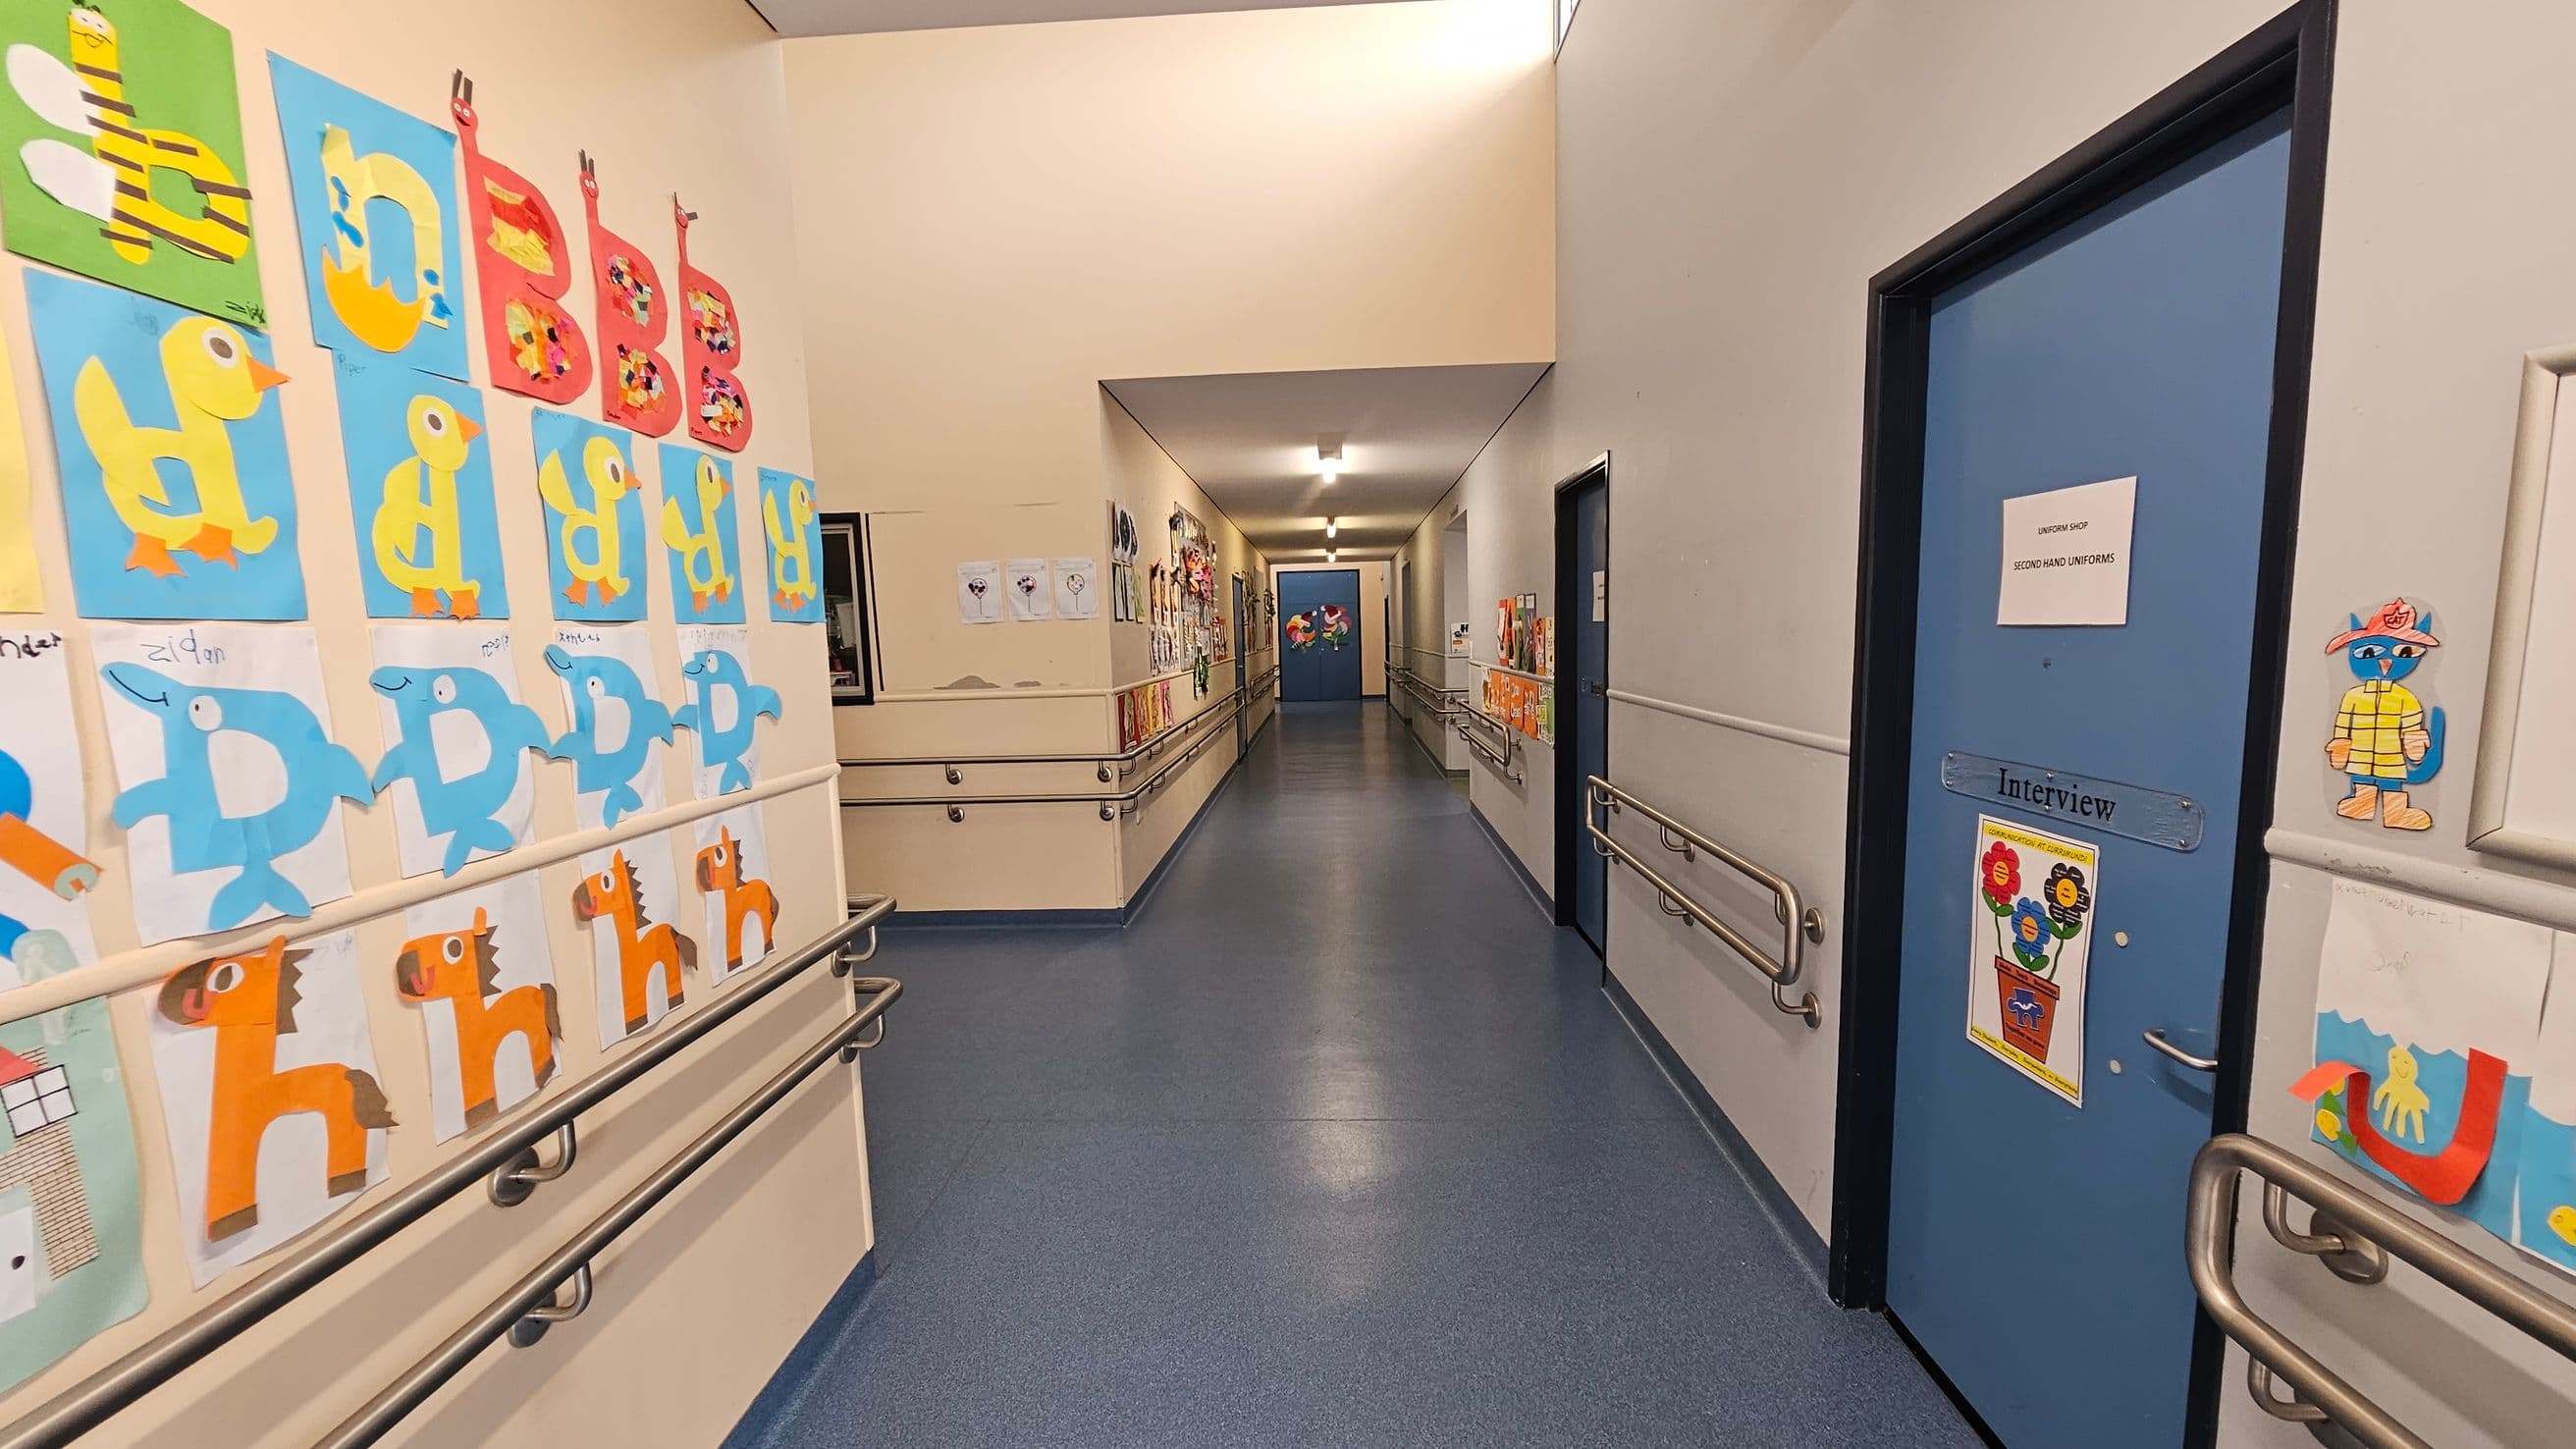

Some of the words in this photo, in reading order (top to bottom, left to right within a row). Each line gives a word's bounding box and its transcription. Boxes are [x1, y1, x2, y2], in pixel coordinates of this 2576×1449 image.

[2038, 523, 2068, 535] UNIFORM
[2069, 521, 2089, 531] SHOP
[2013, 560, 2042, 570] SECOND
[2043, 557, 2066, 568] HAND
[2068, 553, 2115, 566] UNIFORMS
[1998, 768, 2117, 822] Interview
[2037, 841, 2045, 851] AT
